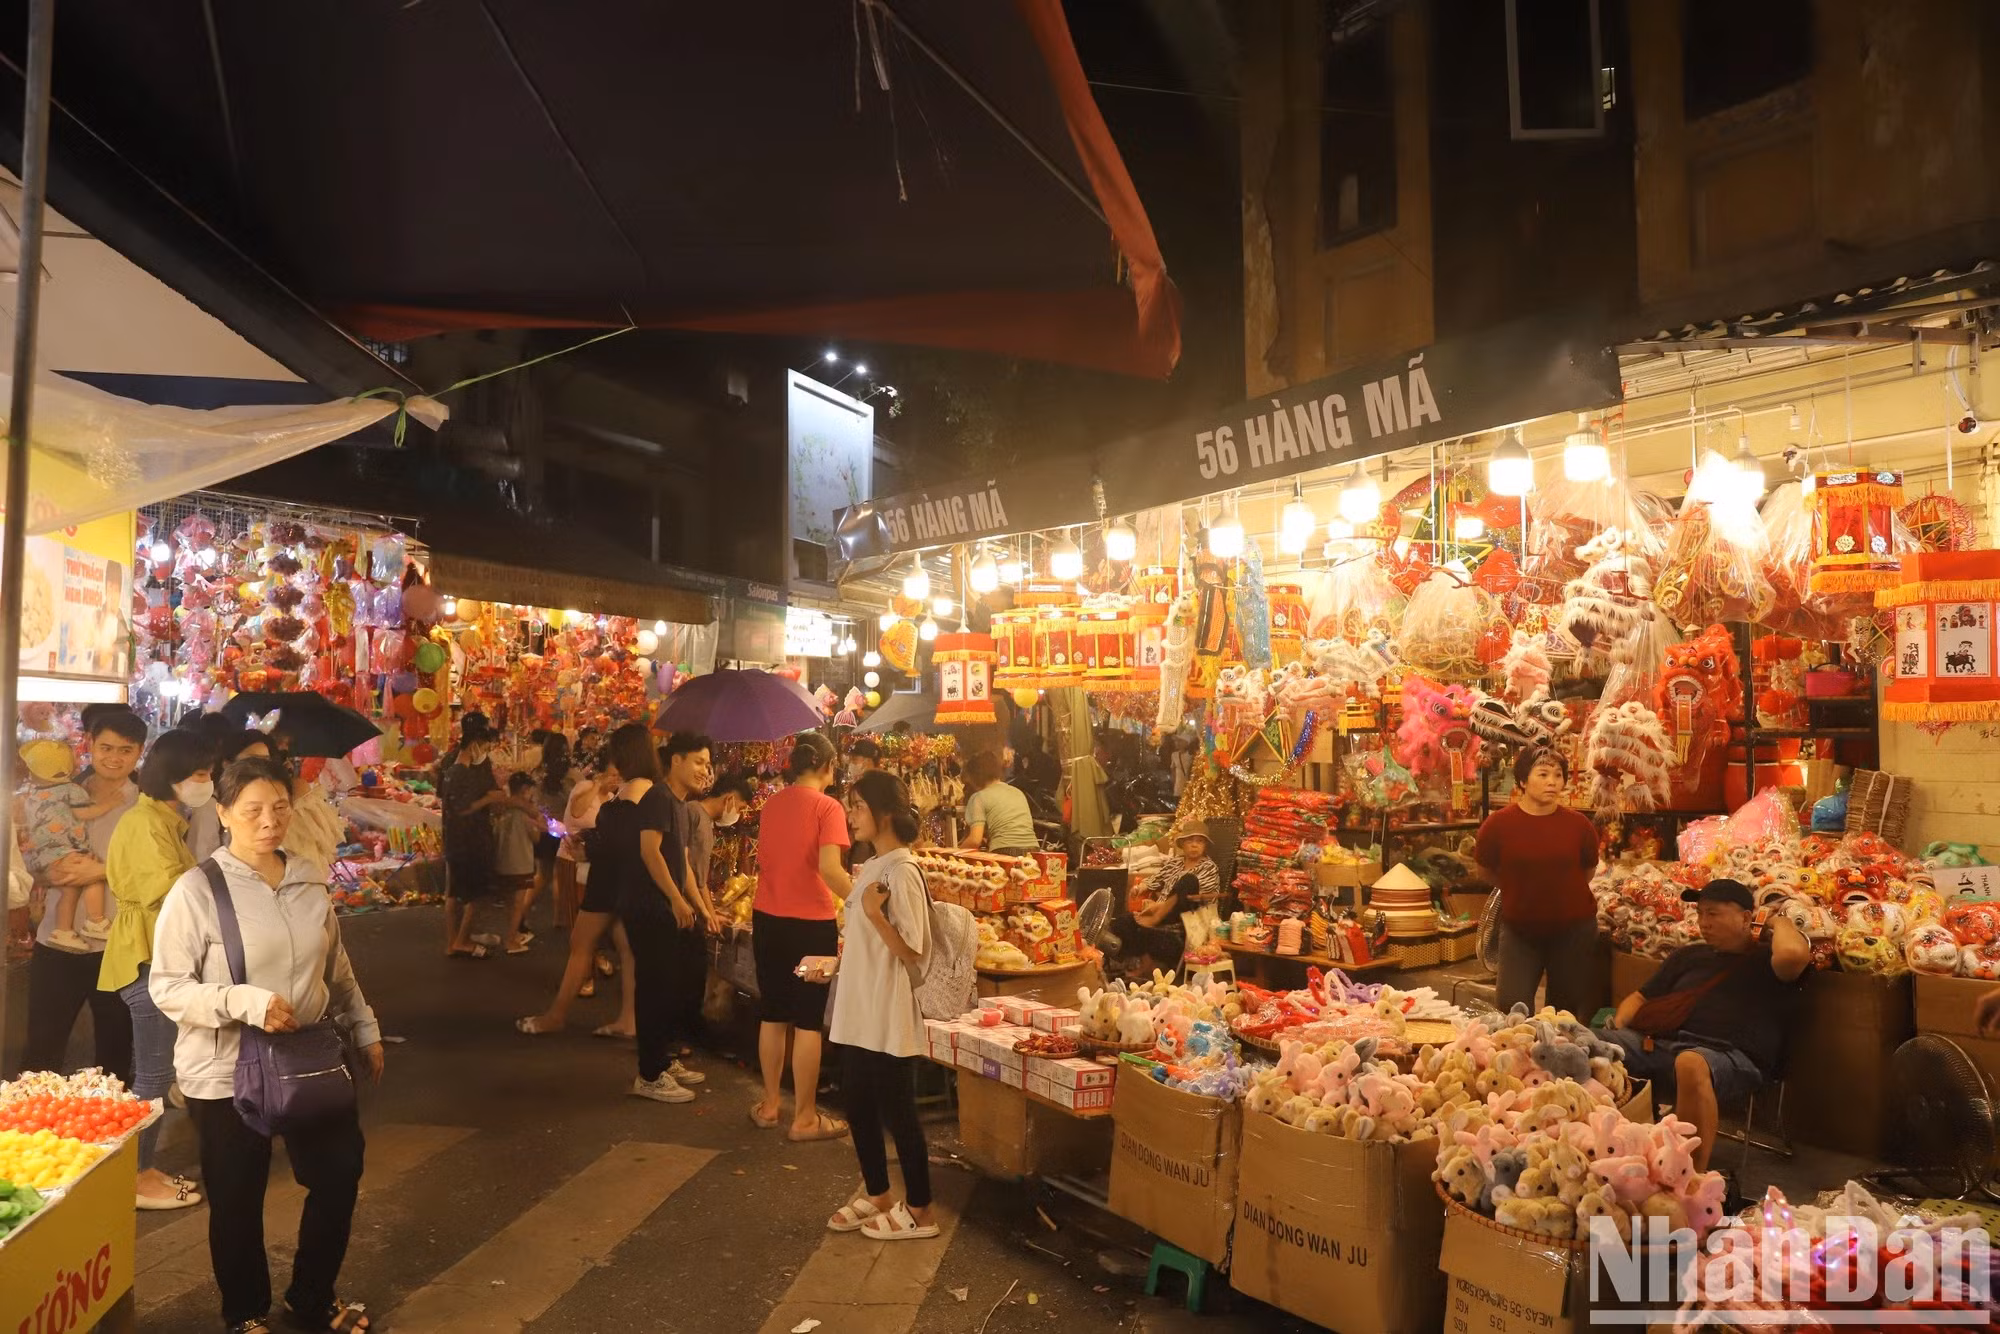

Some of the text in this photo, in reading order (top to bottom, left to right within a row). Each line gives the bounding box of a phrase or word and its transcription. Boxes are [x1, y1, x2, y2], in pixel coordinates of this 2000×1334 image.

[1196, 353, 1442, 479] 56 HÀNG MÃ
[884, 479, 1009, 544] 56 HÀNG MÃ
[747, 583, 778, 602] Salonpas
[1121, 1132, 1210, 1187] DIAN DONG WAN JU
[1244, 1200, 1367, 1267] DIAN DONG WAN JU
[1455, 1297, 1469, 1315] KGS
